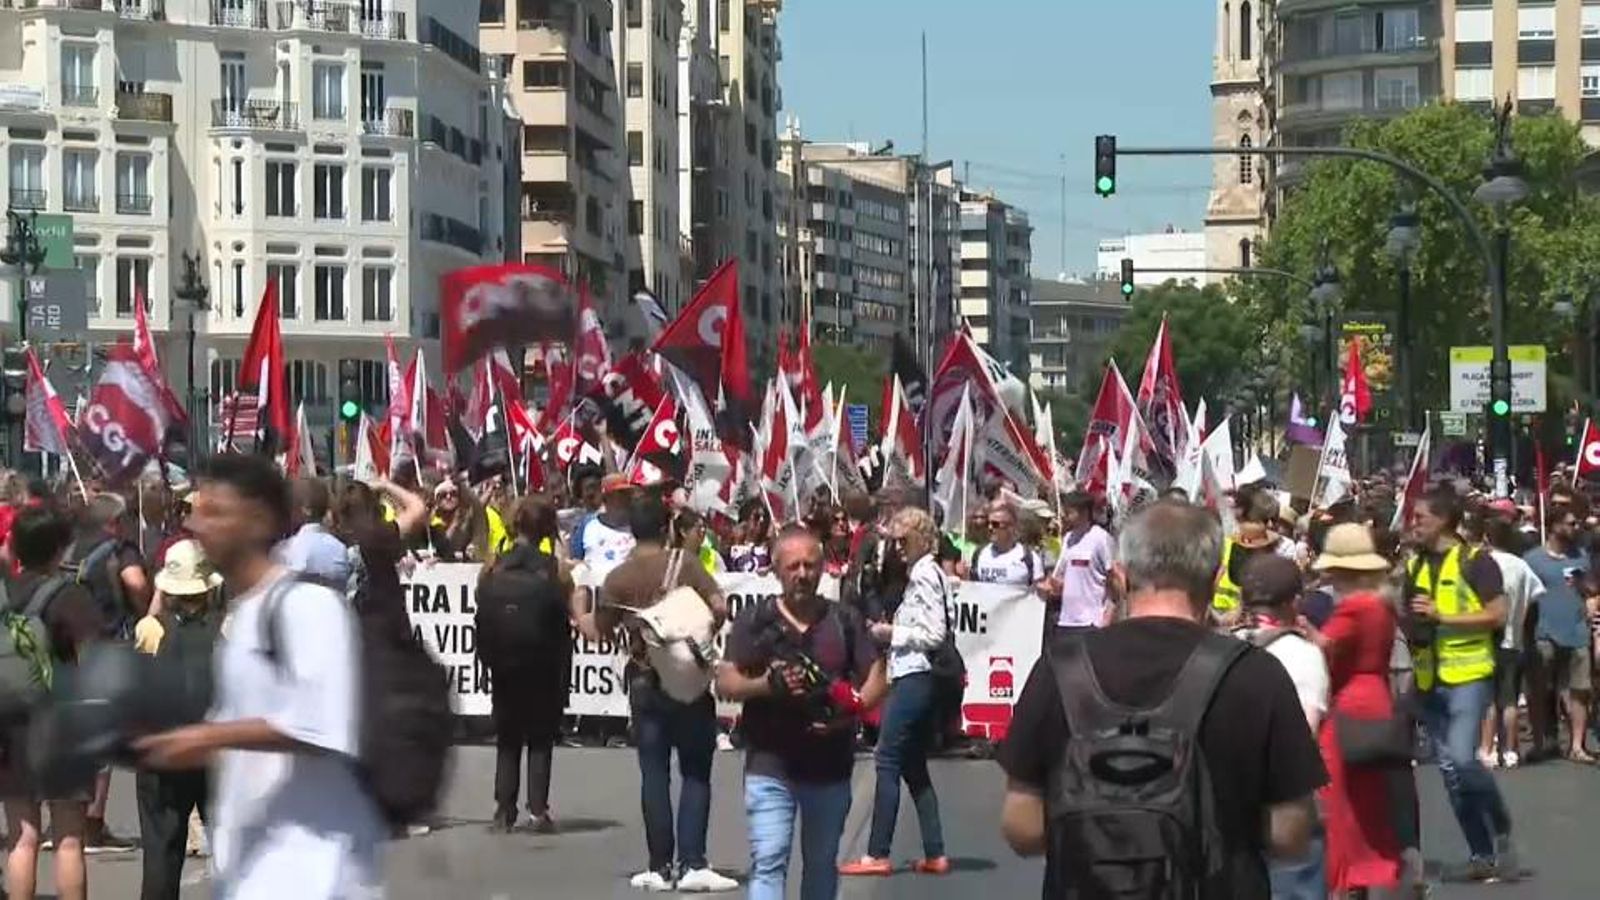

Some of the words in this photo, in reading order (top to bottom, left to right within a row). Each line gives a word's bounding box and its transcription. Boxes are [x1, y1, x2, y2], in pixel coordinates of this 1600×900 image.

[87, 403, 147, 467] CGT
[557, 438, 604, 466] CN
[990, 687, 1013, 697] CGT
